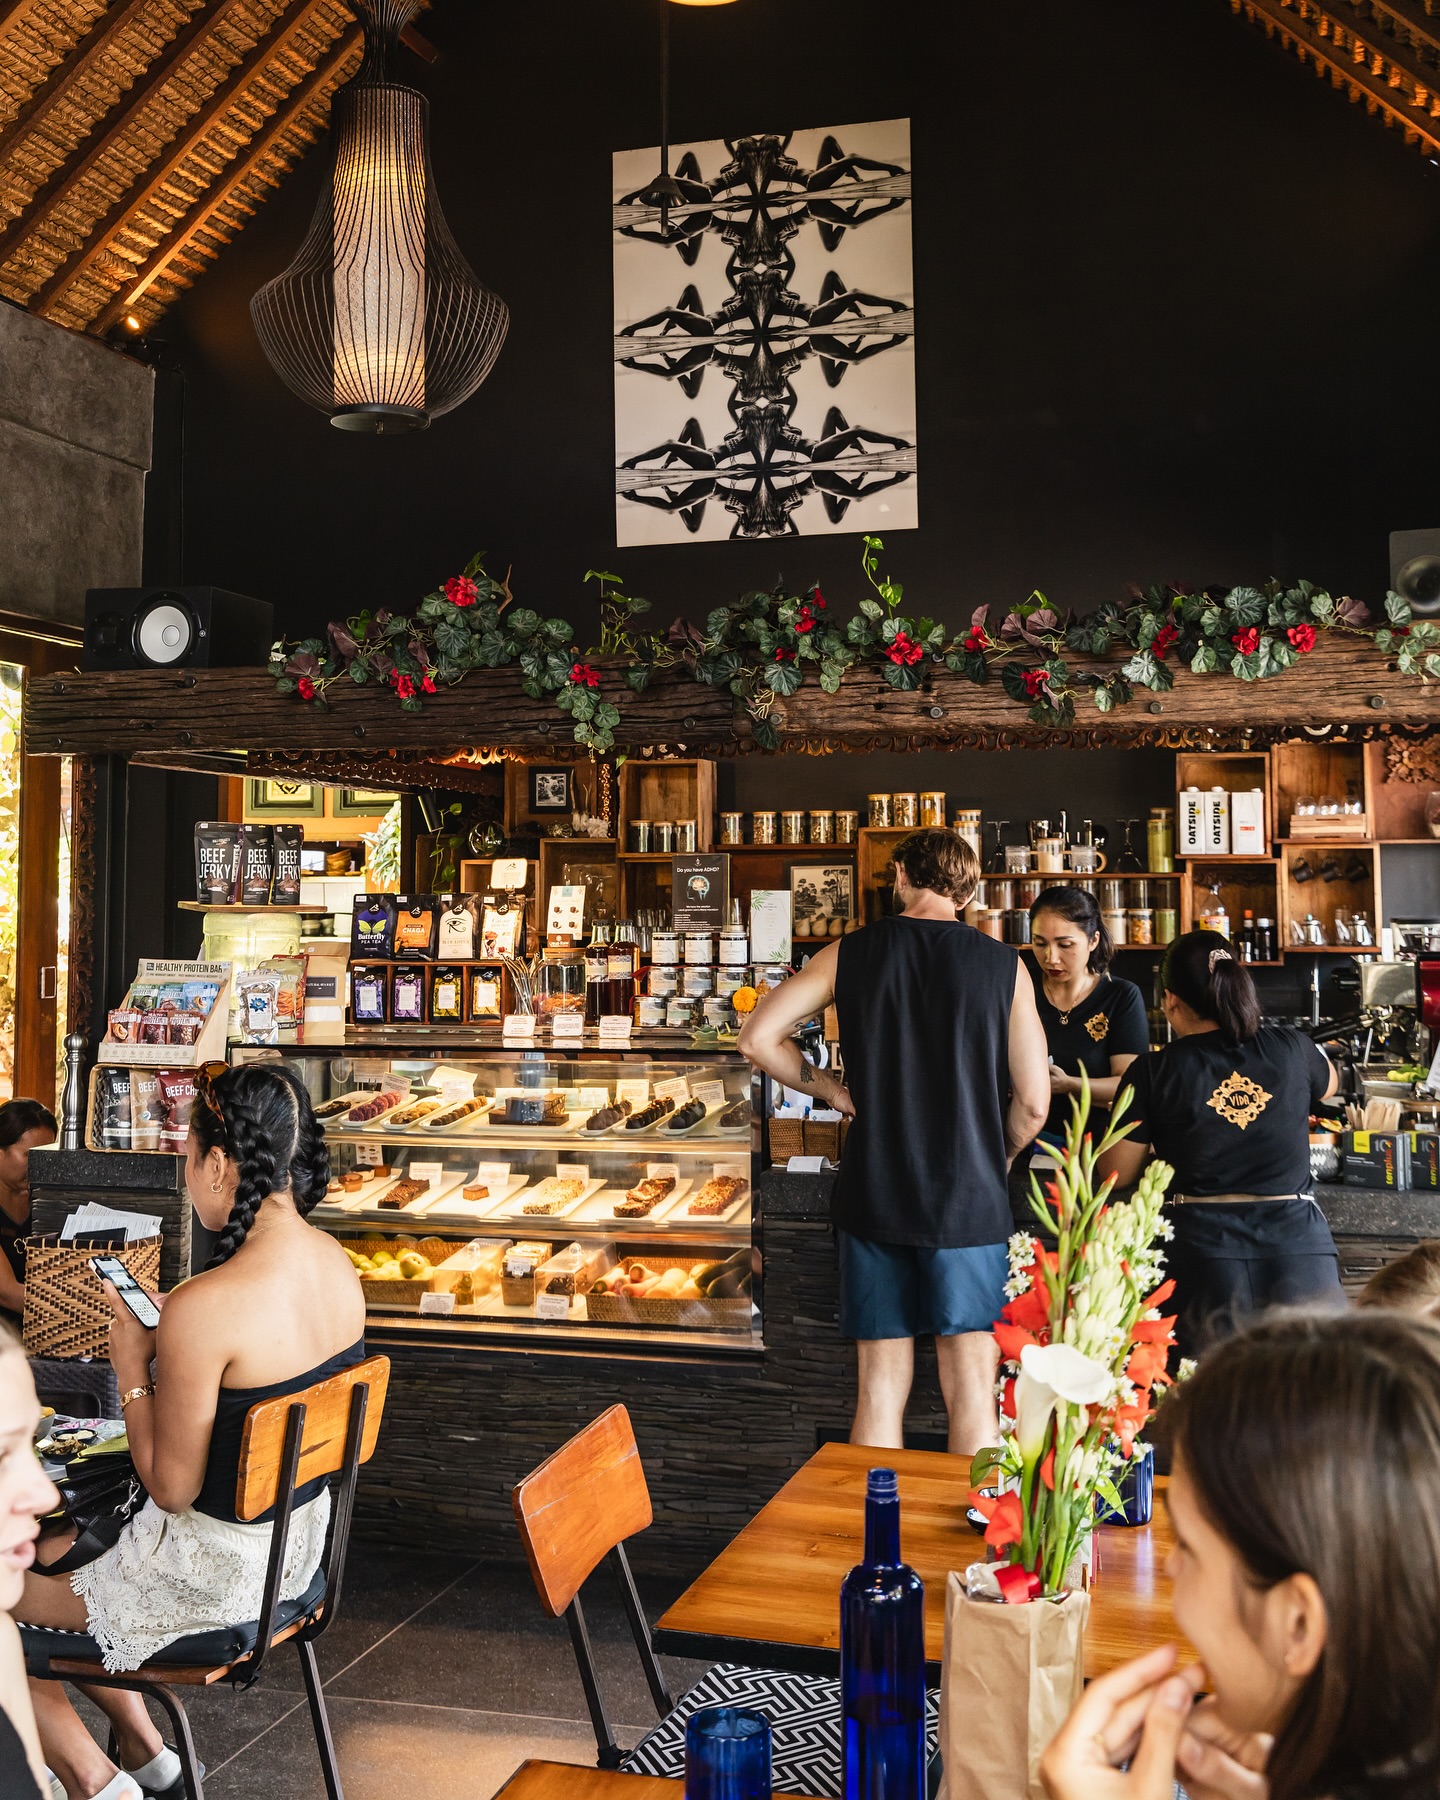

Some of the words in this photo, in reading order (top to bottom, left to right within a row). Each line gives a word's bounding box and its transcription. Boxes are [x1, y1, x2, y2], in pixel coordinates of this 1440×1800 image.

[1188, 801, 1196, 844] OATSIDE
[1213, 801, 1221, 844] OATSIDE
[200, 848, 226, 863] BEEF
[248, 849, 267, 864] BEEF
[279, 850, 297, 864] BEEF
[199, 864, 231, 879] JERKY
[244, 865, 271, 880] JERKY
[357, 933, 385, 941] Butterfly
[156, 962, 182, 972] HEALTHY
[184, 963, 209, 973] PROTEIN
[113, 1082, 130, 1093] BEEF
[138, 1081, 156, 1093] BEEF
[165, 1084, 184, 1097] BEEF
[1384, 1149, 1394, 1184] tenplus
[1429, 1150, 1437, 1185] tenplus
